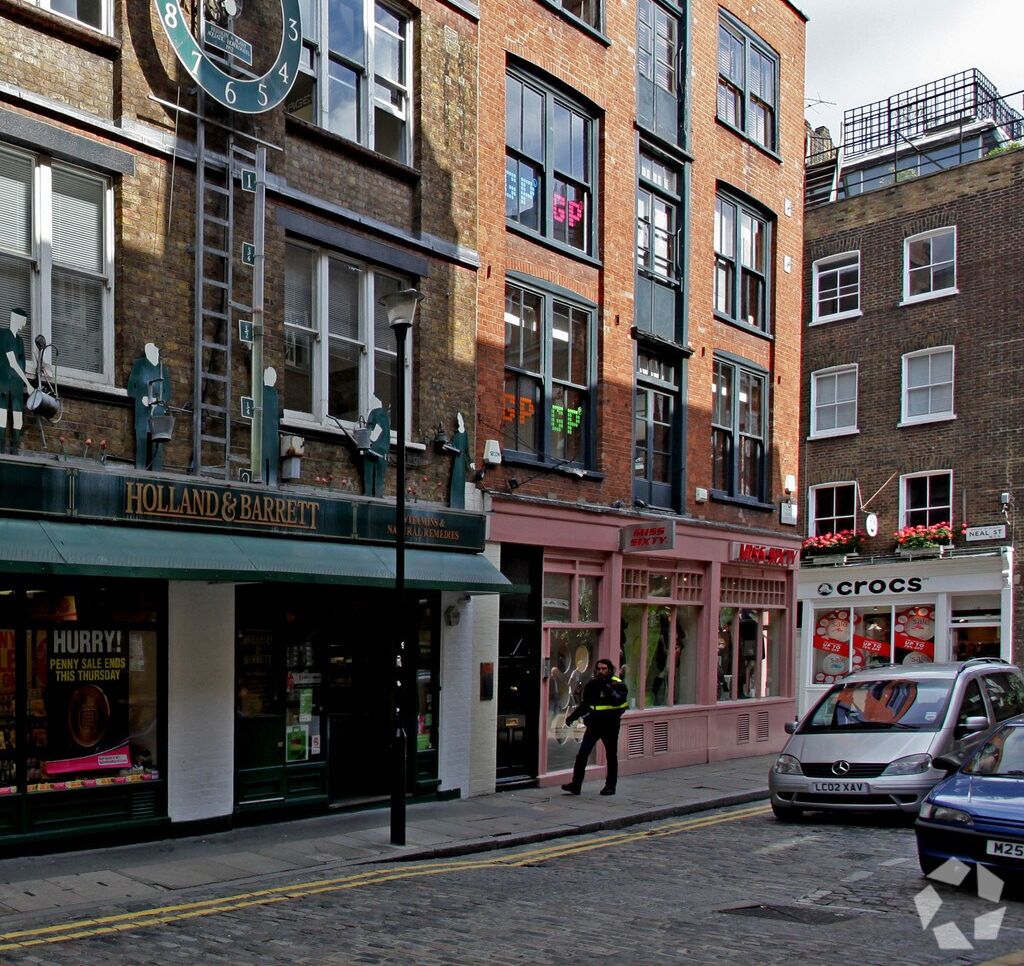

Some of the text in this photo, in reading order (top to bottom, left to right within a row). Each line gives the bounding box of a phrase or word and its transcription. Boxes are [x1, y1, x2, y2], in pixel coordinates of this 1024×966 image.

[164, 2, 178, 29] 8
[288, 17, 299, 42] 3
[191, 50, 202, 75] 7
[278, 64, 289, 84] 4
[225, 81, 237, 104] 6
[258, 84, 268, 106] 5
[125, 481, 320, 530] HOLLAND & BARRETT
[404, 514, 446, 528] VITAMINS &
[424, 527, 460, 540] REMEDIES
[630, 536, 666, 547] SIXTY
[633, 527, 665, 537] MISS
[739, 543, 798, 565] MISS SIXTY
[837, 577, 922, 596] crocs
[53, 629, 122, 654] HURRY!
[50, 657, 126, 670] PENNY SALE ENDS
[55, 669, 120, 683] THIS THURSDAY
[815, 783, 863, 792] LC02 XAV
[994, 842, 1023, 856] M25
